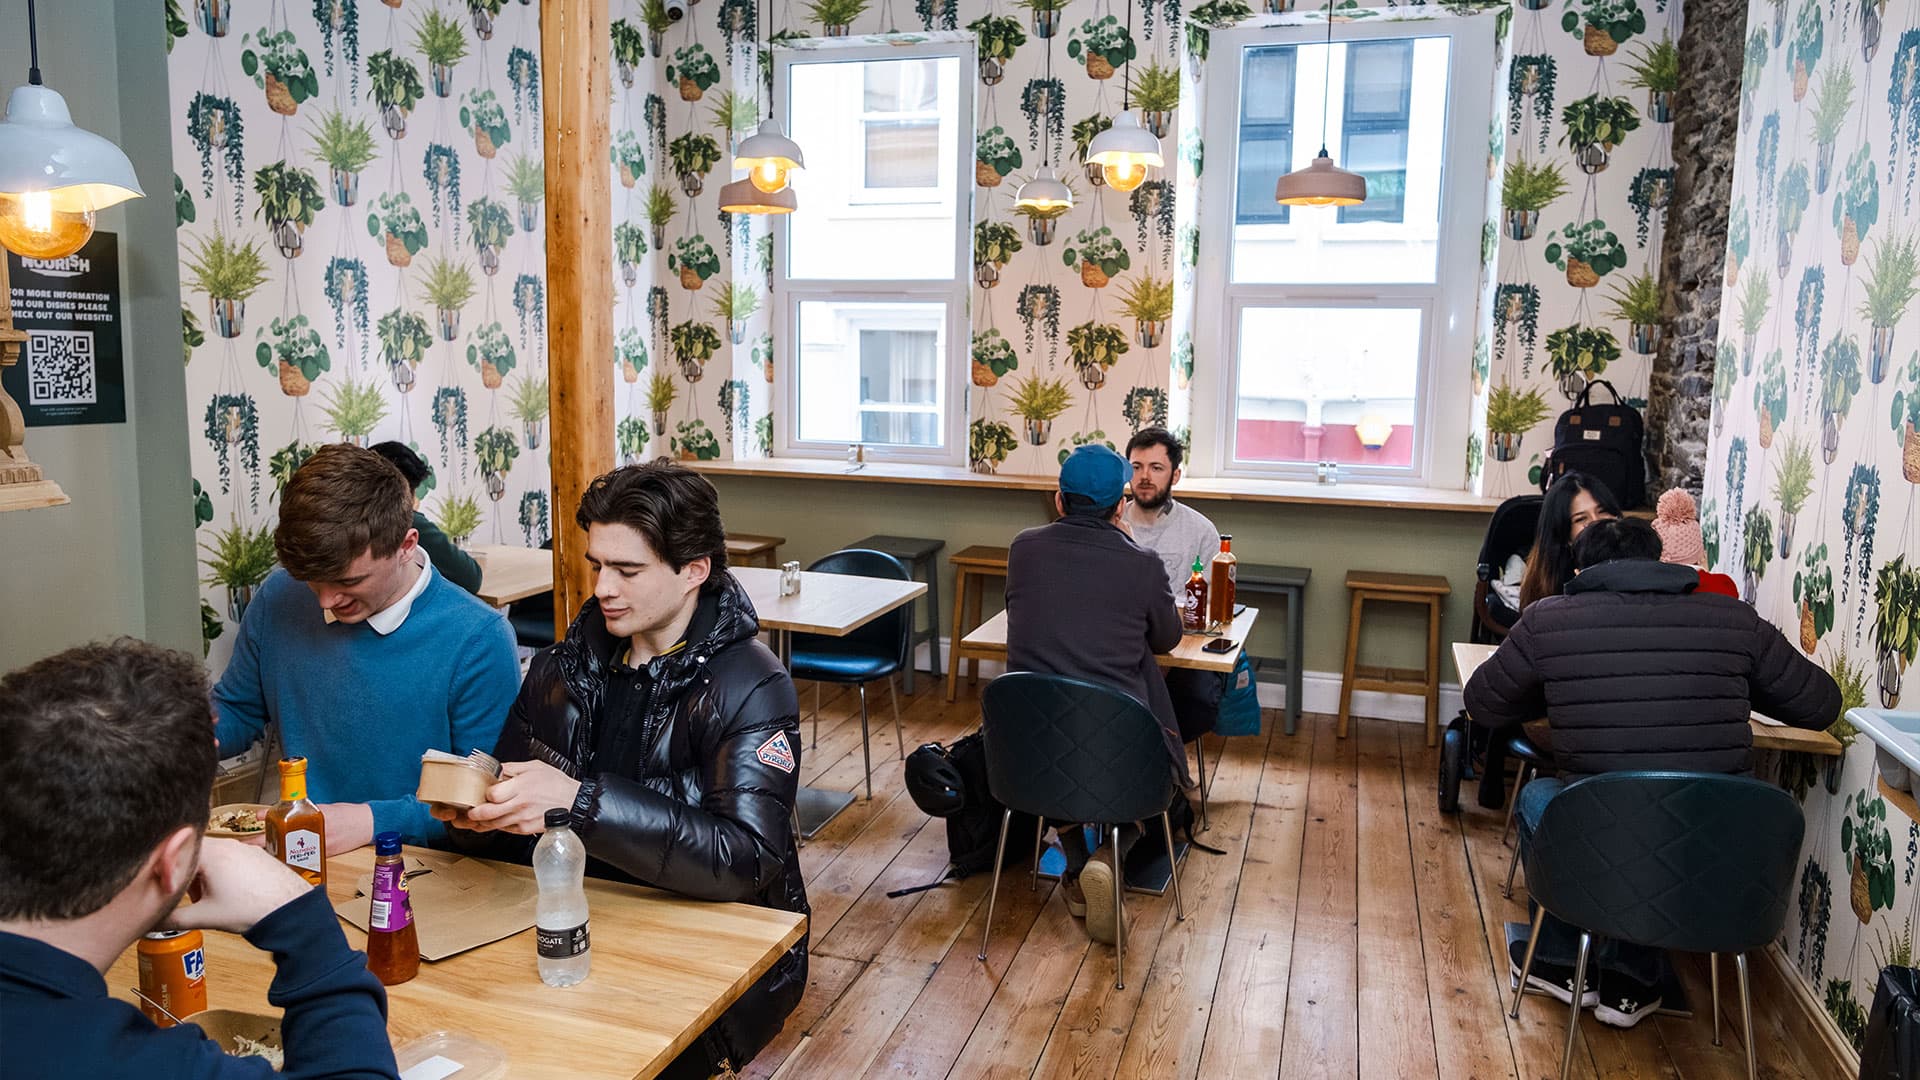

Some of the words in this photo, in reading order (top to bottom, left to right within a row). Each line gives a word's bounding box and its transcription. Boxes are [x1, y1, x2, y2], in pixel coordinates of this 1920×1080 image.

[21, 254, 90, 272] NOURISH
[10, 288, 24, 296] OR
[26, 289, 51, 298] MORE
[53, 290, 110, 301] INFORMATION
[11, 299, 24, 308] ON
[26, 300, 44, 308] OUR
[46, 301, 76, 310] DISHES
[78, 302, 108, 311] PLEASE
[11, 310, 34, 319] HECK
[36, 311, 54, 319] OUT
[55, 312, 73, 320] OUR
[74, 313, 113, 322] WEBSITE!
[183, 947, 205, 976] FA
